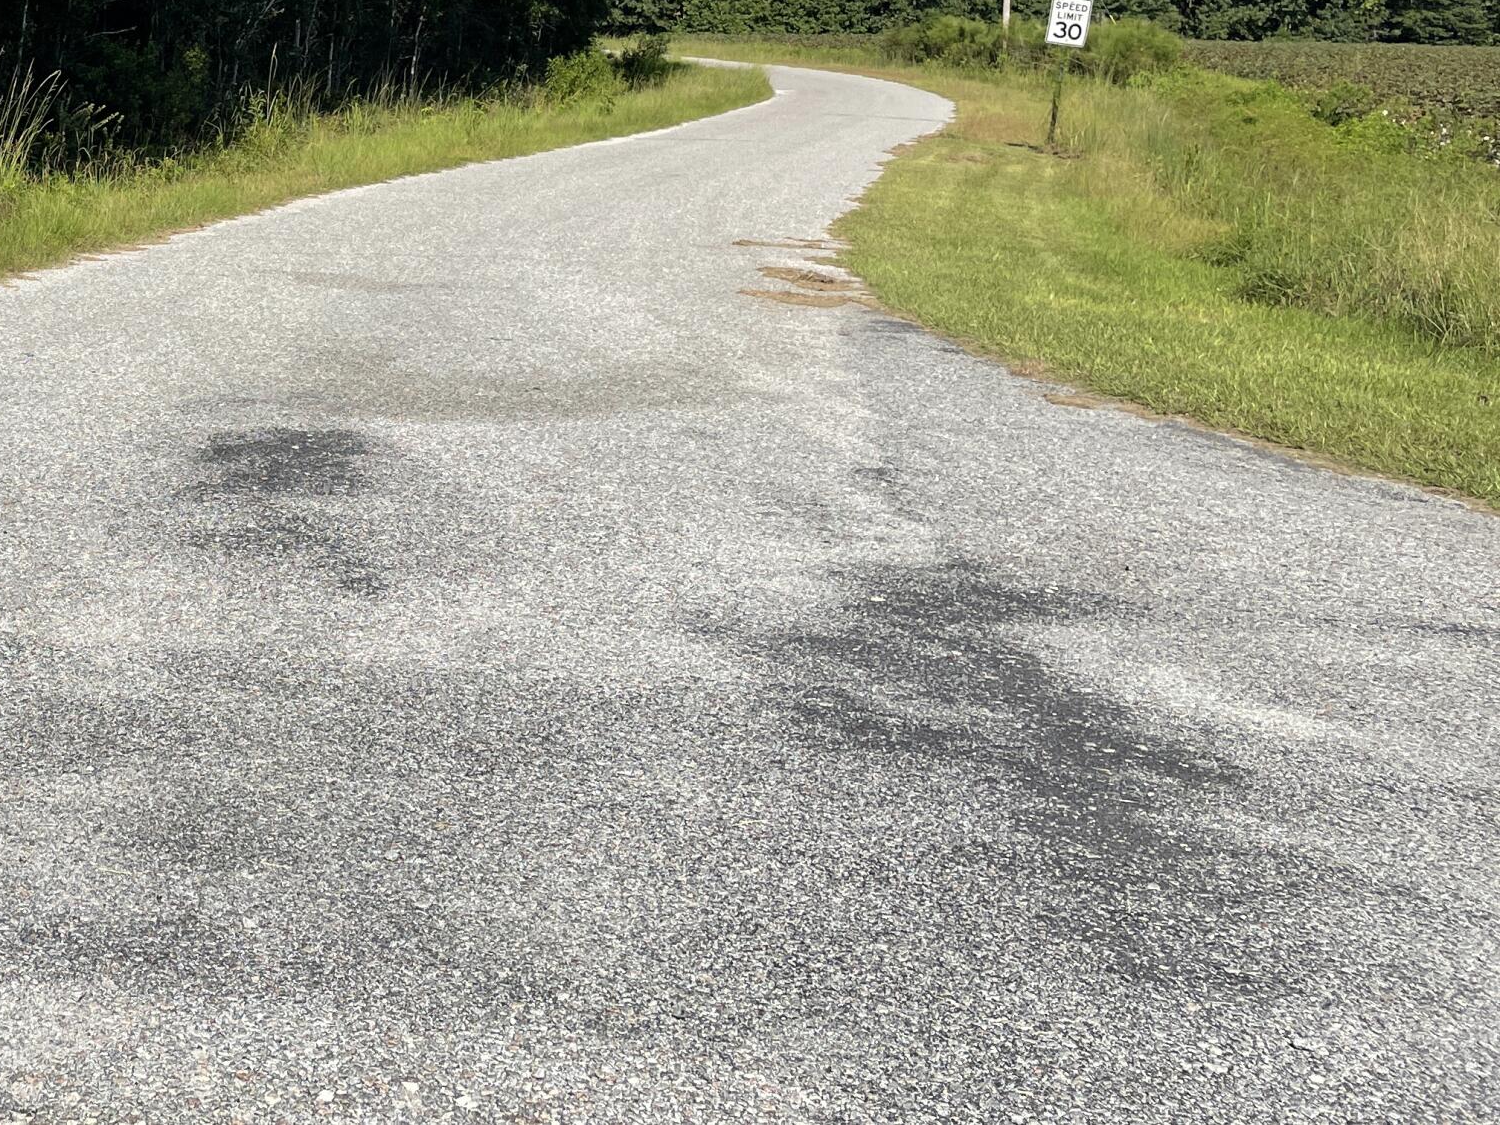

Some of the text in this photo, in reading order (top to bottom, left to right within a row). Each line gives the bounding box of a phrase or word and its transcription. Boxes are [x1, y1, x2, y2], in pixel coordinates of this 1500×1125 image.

[1056, 1, 1088, 12] SPEED
[1057, 12, 1084, 21] LIMIT
[1053, 21, 1082, 40] 30
